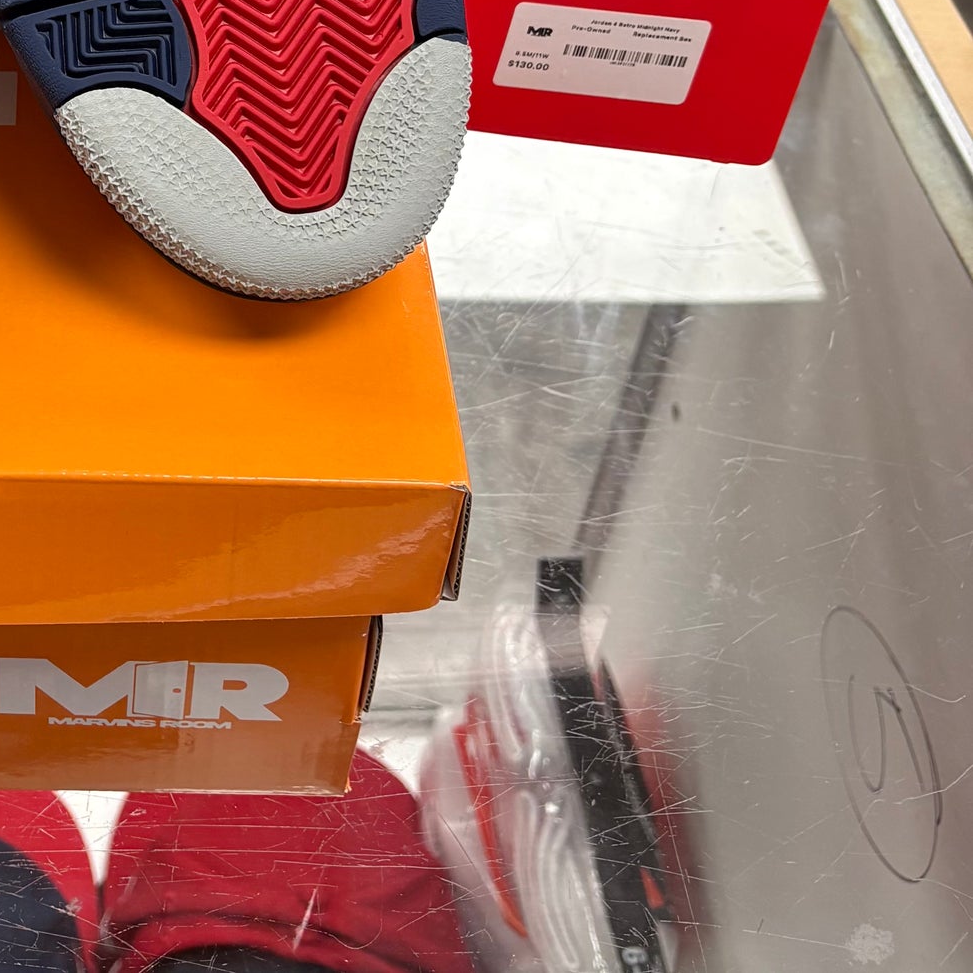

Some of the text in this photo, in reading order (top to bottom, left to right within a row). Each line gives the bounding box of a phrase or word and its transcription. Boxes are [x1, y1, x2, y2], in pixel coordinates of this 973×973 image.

[571, 24, 612, 35] Pre-Owned
[590, 19, 612, 27] Jordan
[636, 23, 664, 32] Midnight
[665, 26, 681, 34] Navy
[632, 31, 678, 41] Replacement
[508, 59, 550, 71] $130.00
[48, 716, 232, 729] MARVINS ROOM
